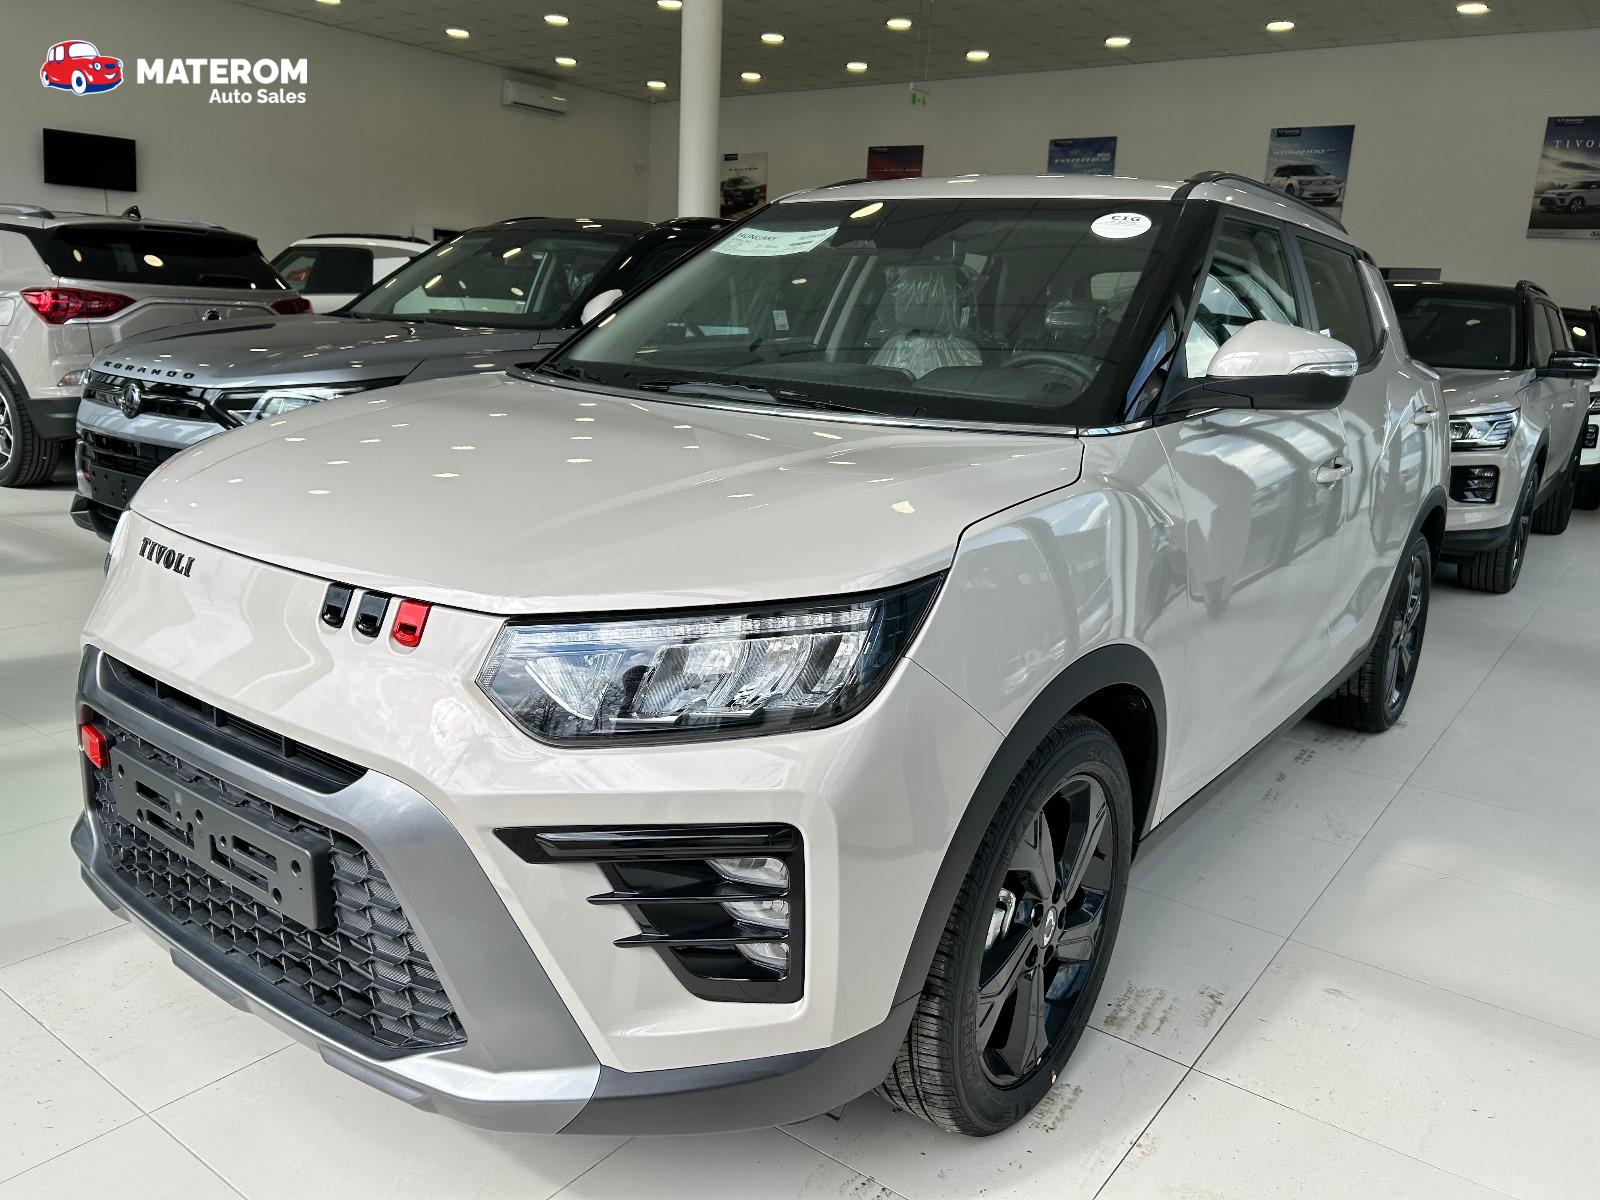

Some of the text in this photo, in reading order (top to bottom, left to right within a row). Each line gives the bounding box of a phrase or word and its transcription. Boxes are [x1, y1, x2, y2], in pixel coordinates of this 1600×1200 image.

[1553, 139, 1600, 149] TIVO
[103, 361, 195, 380] KORANDO
[139, 536, 196, 578] TIVOLI
